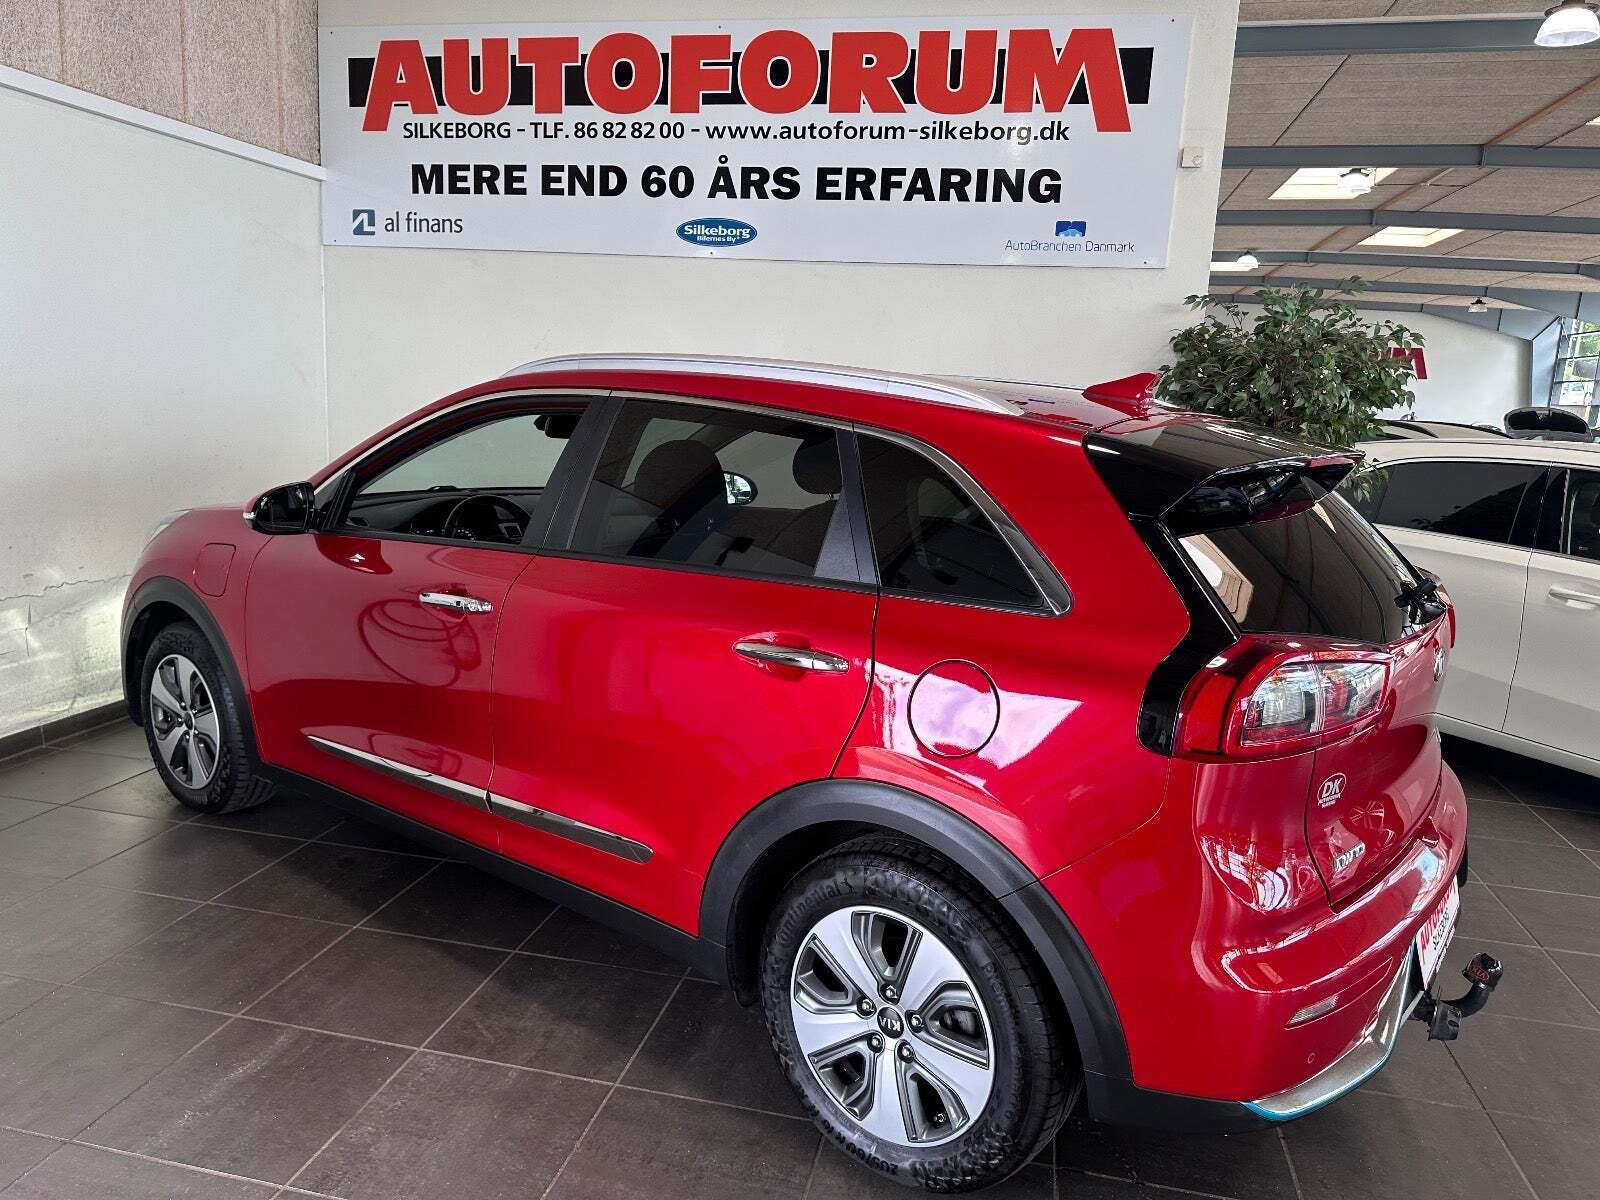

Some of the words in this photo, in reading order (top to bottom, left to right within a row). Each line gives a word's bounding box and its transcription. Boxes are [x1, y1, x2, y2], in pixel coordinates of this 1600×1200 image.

[362, 28, 1132, 132] AUTOFORUM
[402, 121, 511, 139] SILKEBORG
[530, 121, 569, 139] TLF.
[705, 119, 1070, 145] www.autoforum-silkeborg.dk
[411, 163, 527, 195] MERE
[541, 164, 628, 197] END
[641, 165, 695, 199] 60
[707, 154, 801, 200] ÅRS
[815, 166, 1062, 203] ERFARING
[384, 211, 400, 233] al
[406, 211, 463, 234] finans
[684, 224, 751, 240] Silkeborg
[1005, 239, 1082, 252] AutoBranchen
[1085, 240, 1136, 253] Danmark
[1322, 778, 1342, 798] DK
[879, 1015, 901, 1032] KIA
